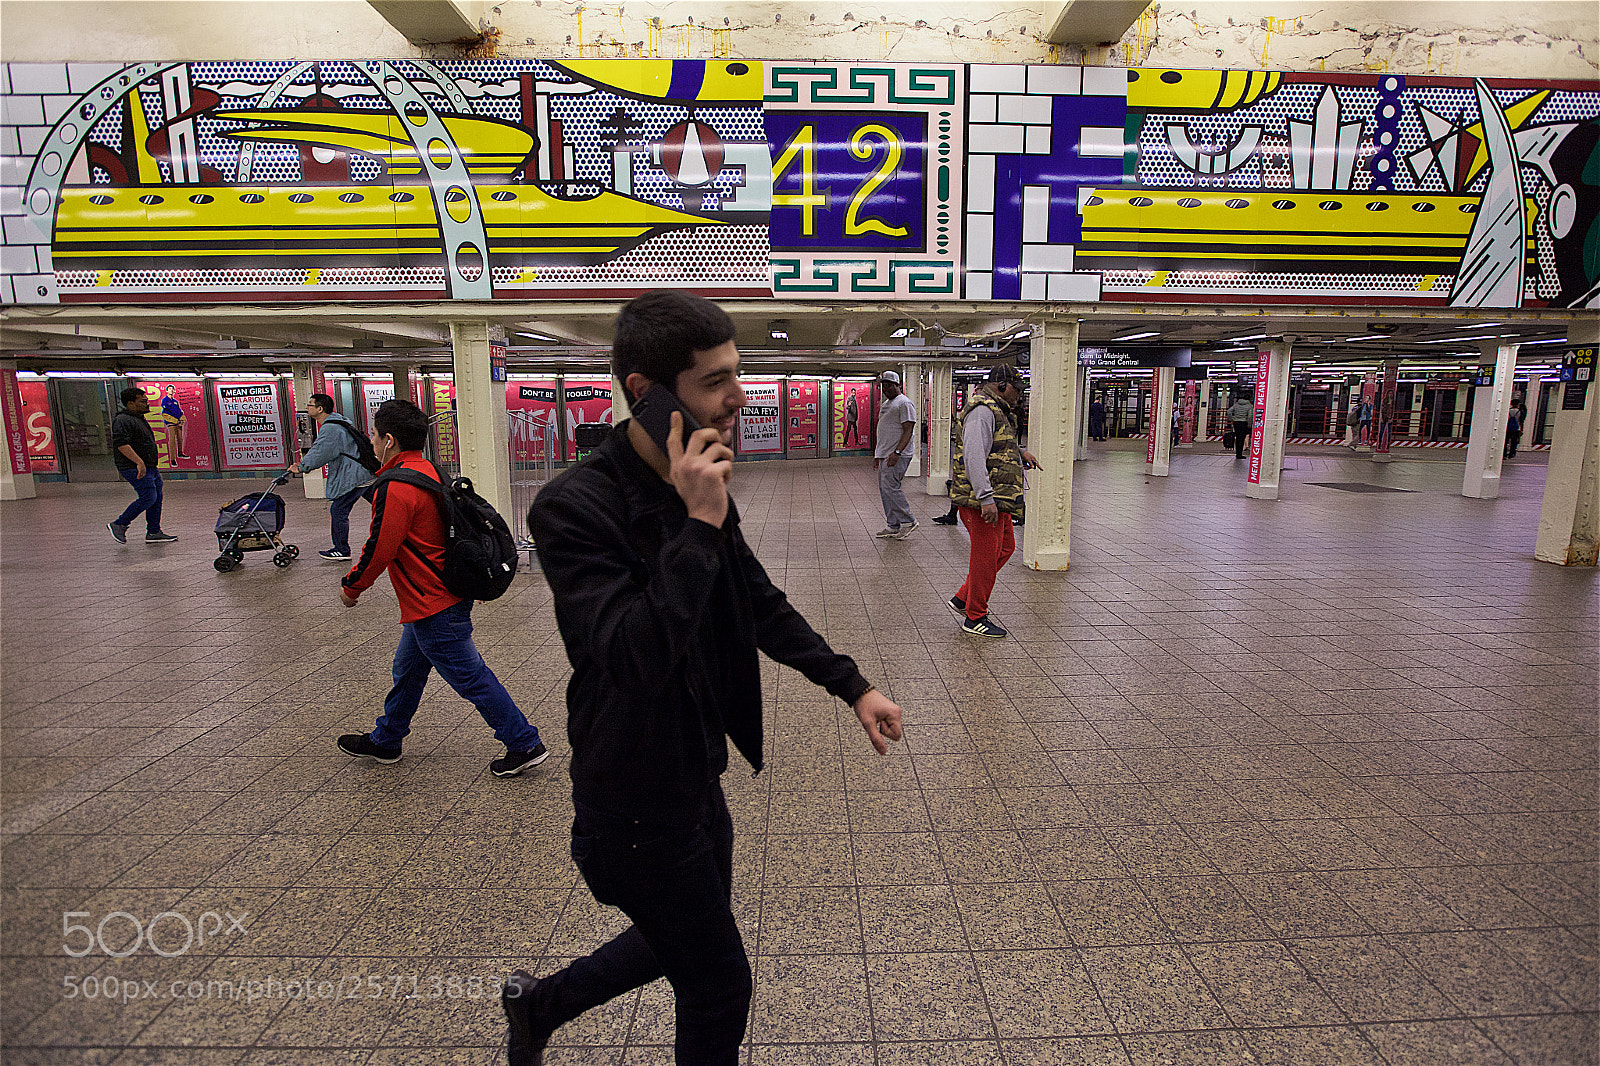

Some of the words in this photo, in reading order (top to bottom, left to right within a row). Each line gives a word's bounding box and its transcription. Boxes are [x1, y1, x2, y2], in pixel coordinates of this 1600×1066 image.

[772, 122, 914, 240] 42
[1259, 354, 1269, 379] GIRLS
[249, 387, 270, 395] GIRLS
[522, 389, 544, 397] DON'T
[566, 390, 592, 398] FOOLED
[1257, 381, 1266, 405] MEAN
[238, 416, 265, 424] EXPERT
[434, 382, 455, 456] NORBURY
[742, 407, 760, 415] TINA
[834, 383, 845, 444] DUVALL
[230, 424, 275, 432] COMEDIANS
[757, 425, 778, 433] LAST
[12, 431, 22, 452] GIRLS
[1252, 430, 1262, 455] GIRLS
[15, 452, 26, 472] MEAN
[1250, 457, 1259, 480] MEAN
